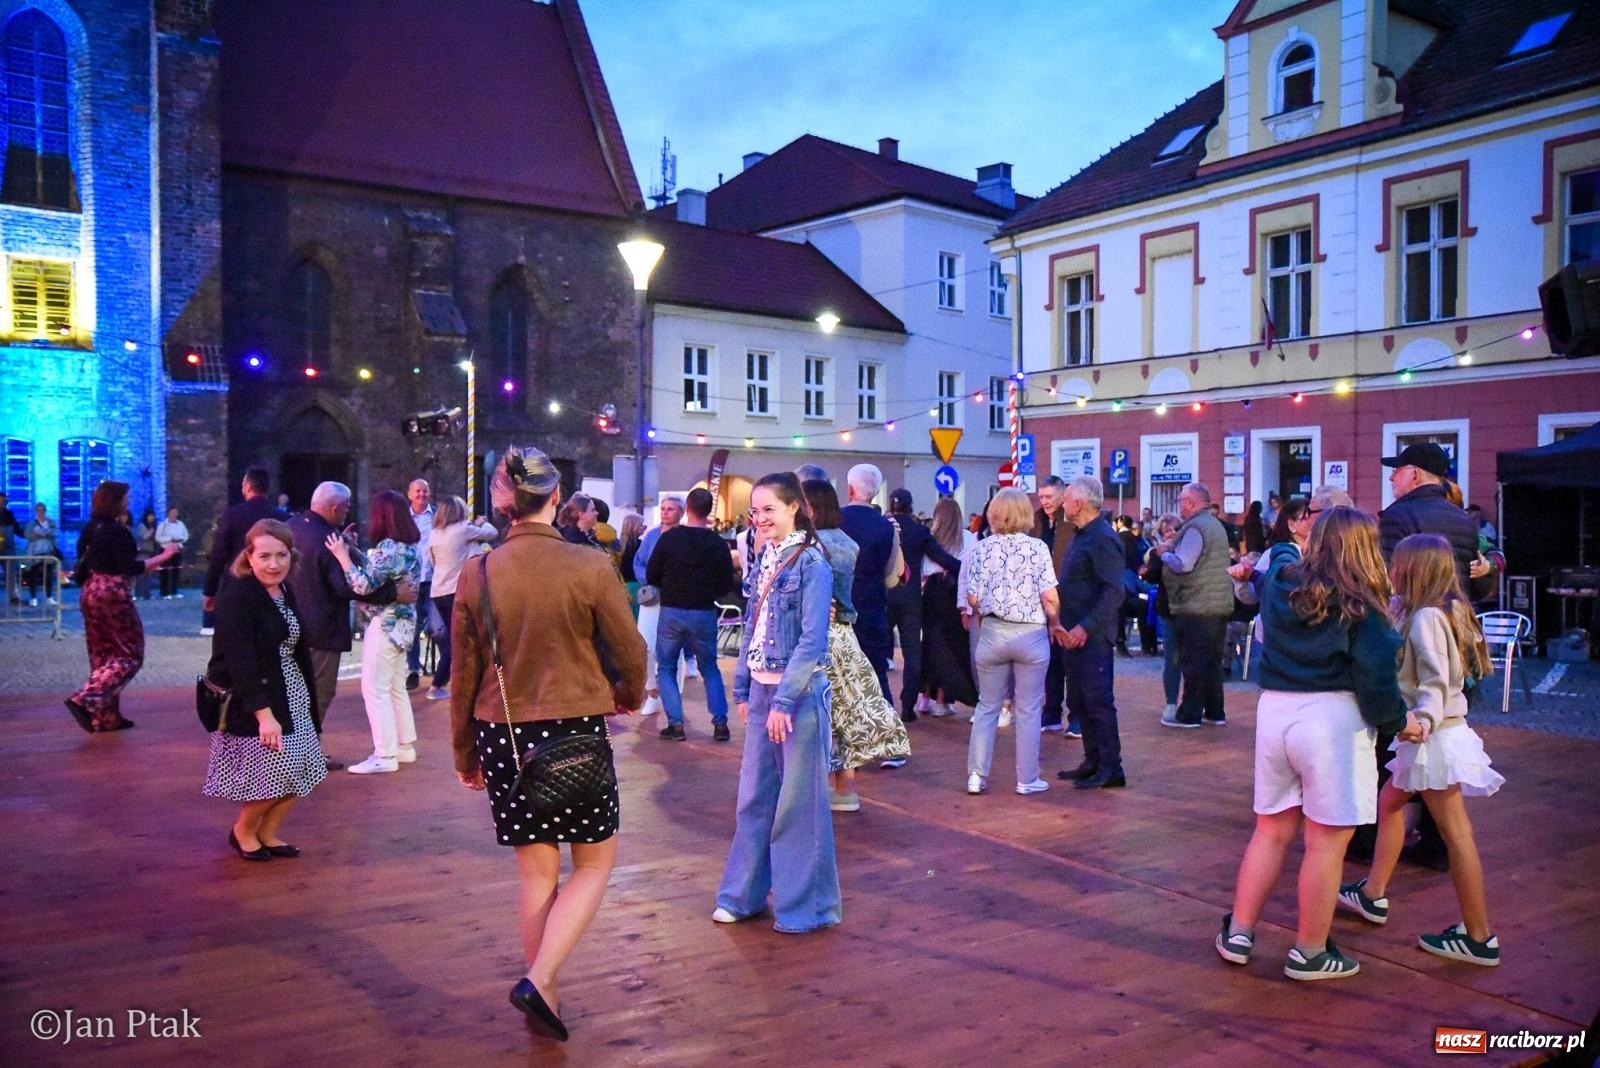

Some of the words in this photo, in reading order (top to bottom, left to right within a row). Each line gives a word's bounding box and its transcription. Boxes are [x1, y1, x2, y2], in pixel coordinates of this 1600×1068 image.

[1018, 439, 1030, 463] P
[1115, 451, 1125, 466] P
[1163, 454, 1179, 468] AG
[1329, 464, 1344, 475] AG
